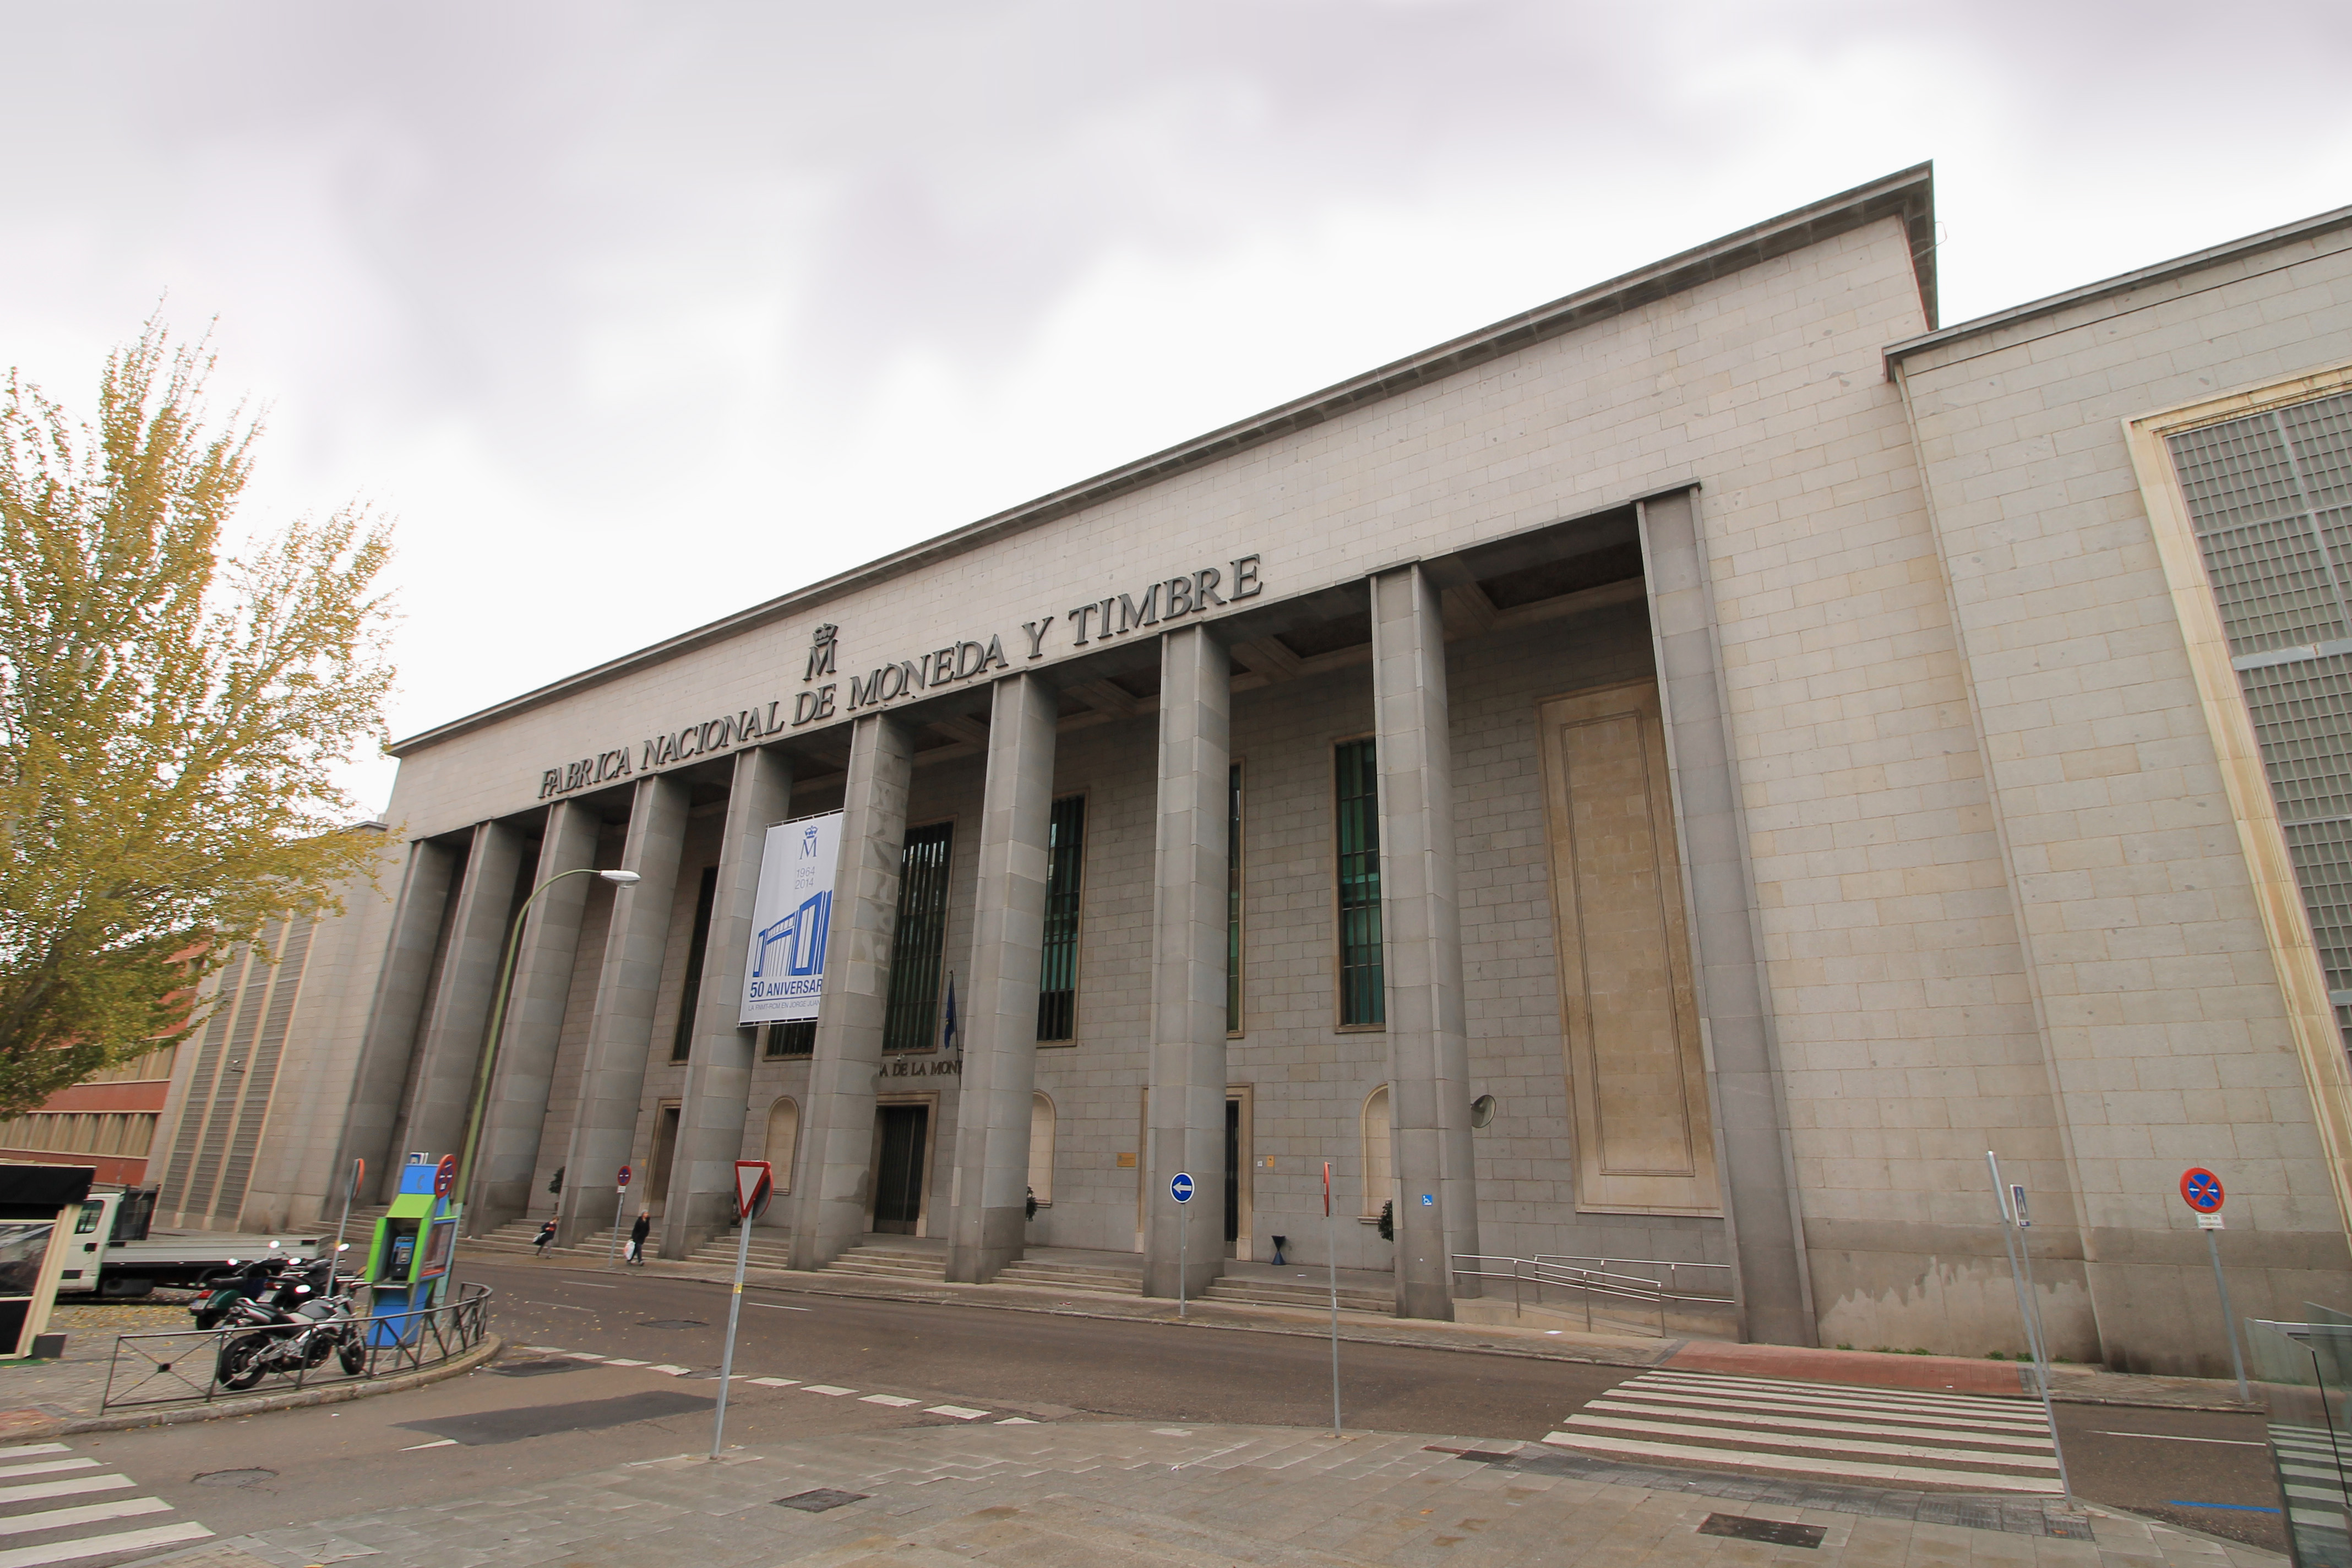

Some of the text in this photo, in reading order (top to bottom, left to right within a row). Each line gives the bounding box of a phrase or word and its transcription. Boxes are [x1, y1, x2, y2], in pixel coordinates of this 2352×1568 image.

[537, 553, 1264, 798] FABRICA NACIONAL DE MONEDA Y TIMBRE
[797, 866, 815, 878] 1964
[794, 878, 814, 889] 2014
[749, 981, 765, 998] 50
[790, 1000, 807, 1008] JORGE
[892, 1063, 908, 1076] DE
[911, 1062, 927, 1076] LA
